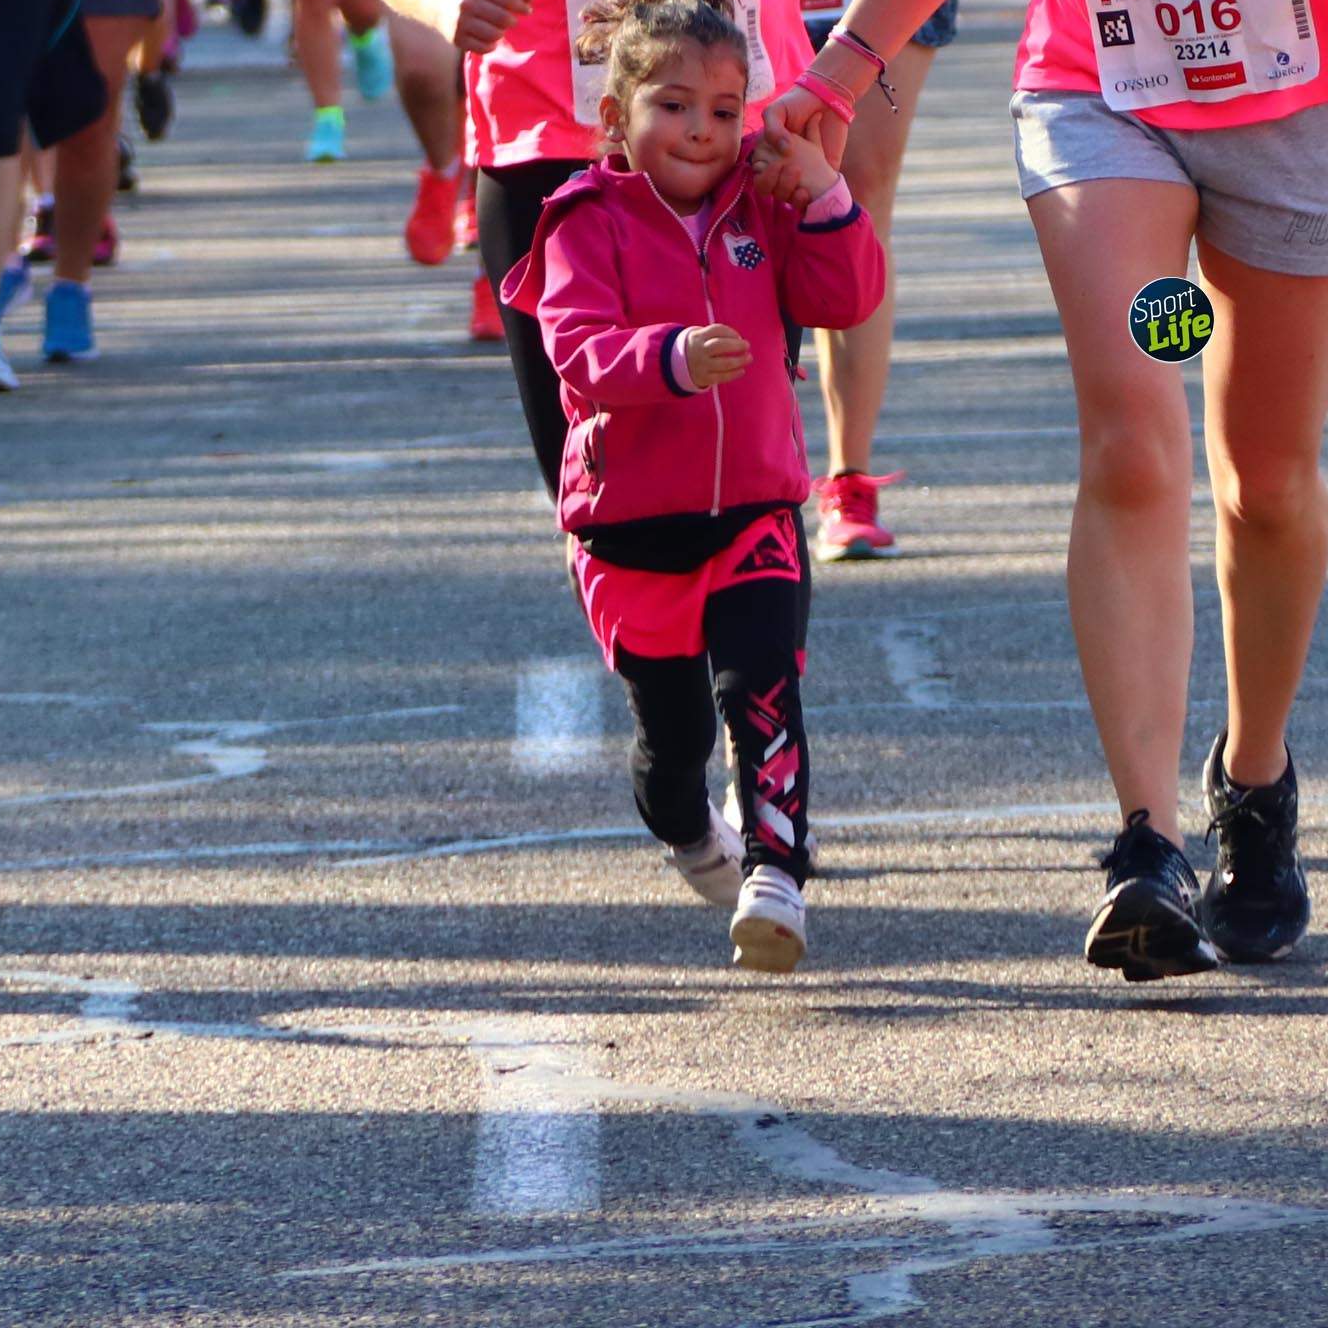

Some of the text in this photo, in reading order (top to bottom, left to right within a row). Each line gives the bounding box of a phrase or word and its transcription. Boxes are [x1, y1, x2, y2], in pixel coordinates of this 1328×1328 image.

[1175, 40, 1231, 60] 23214
[1115, 73, 1169, 94] OYSHO
[1199, 71, 1237, 83] Santander
